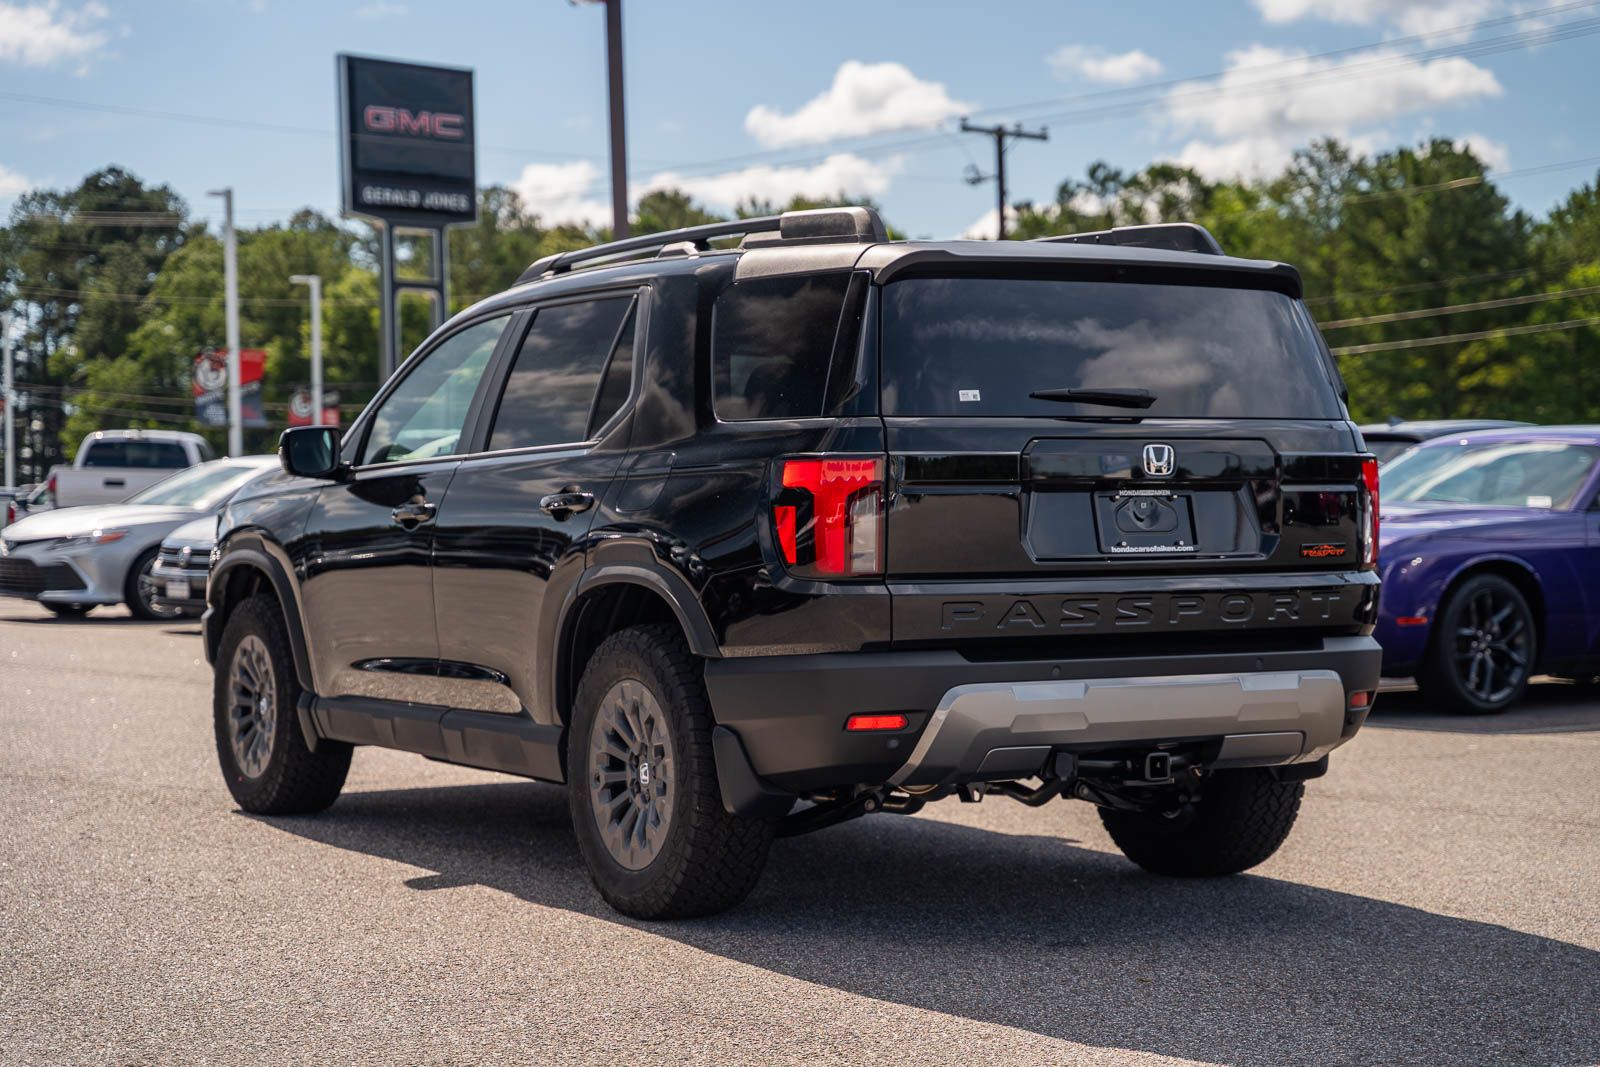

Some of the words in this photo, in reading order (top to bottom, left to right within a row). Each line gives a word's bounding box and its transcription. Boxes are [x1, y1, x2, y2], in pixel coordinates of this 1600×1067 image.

[364, 105, 465, 138] GMC
[362, 186, 420, 208] GERALD
[422, 191, 470, 212] JONES
[940, 592, 1341, 630] PASSPORT
